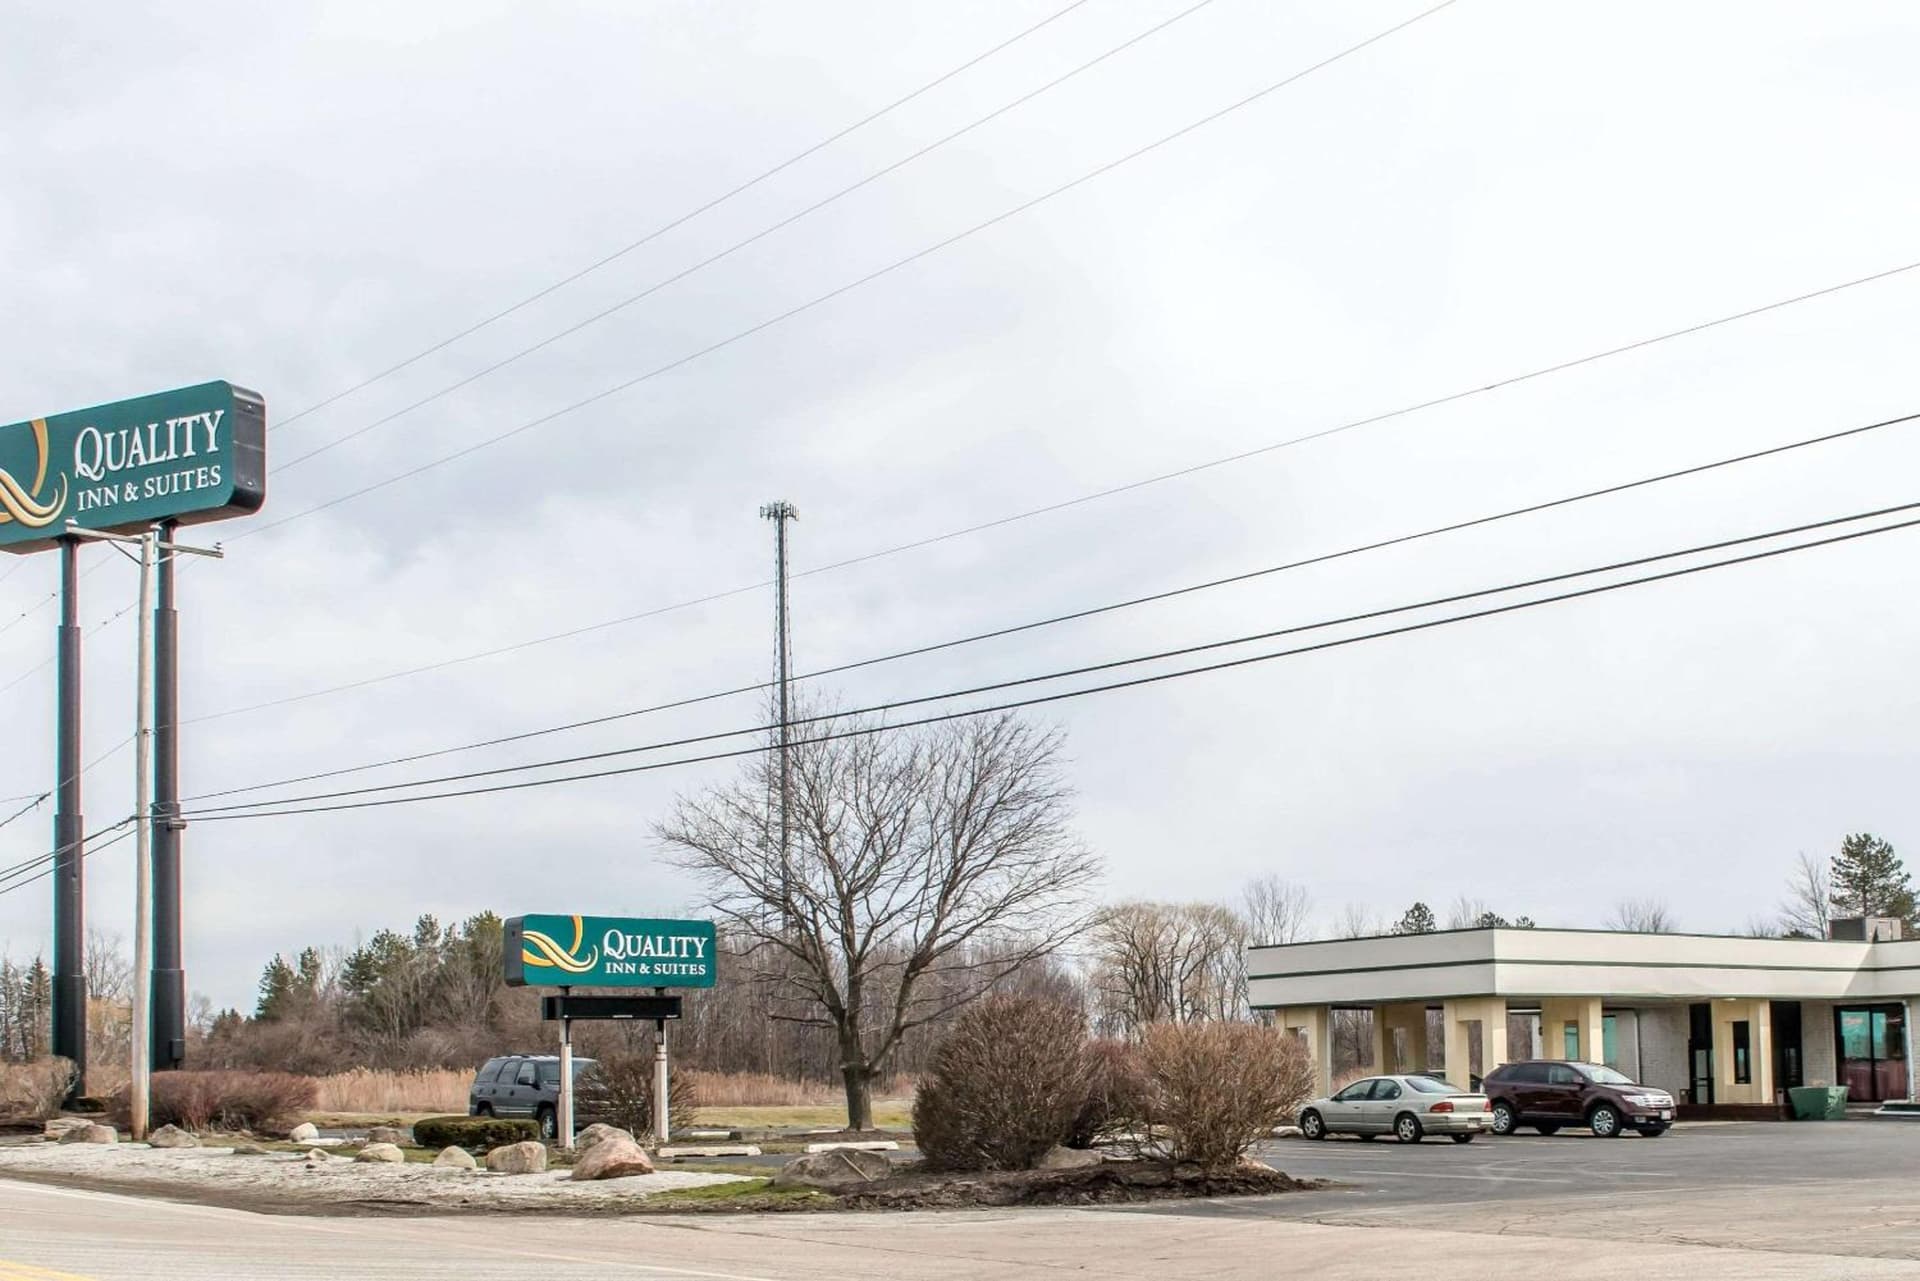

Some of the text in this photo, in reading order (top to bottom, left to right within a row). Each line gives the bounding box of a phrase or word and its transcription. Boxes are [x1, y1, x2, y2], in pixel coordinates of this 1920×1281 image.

[74, 409, 225, 482] QUALITY
[77, 464, 222, 512] INN & SUITES
[603, 928, 708, 960] QUALITY
[605, 962, 706, 976] INN & SUITES
